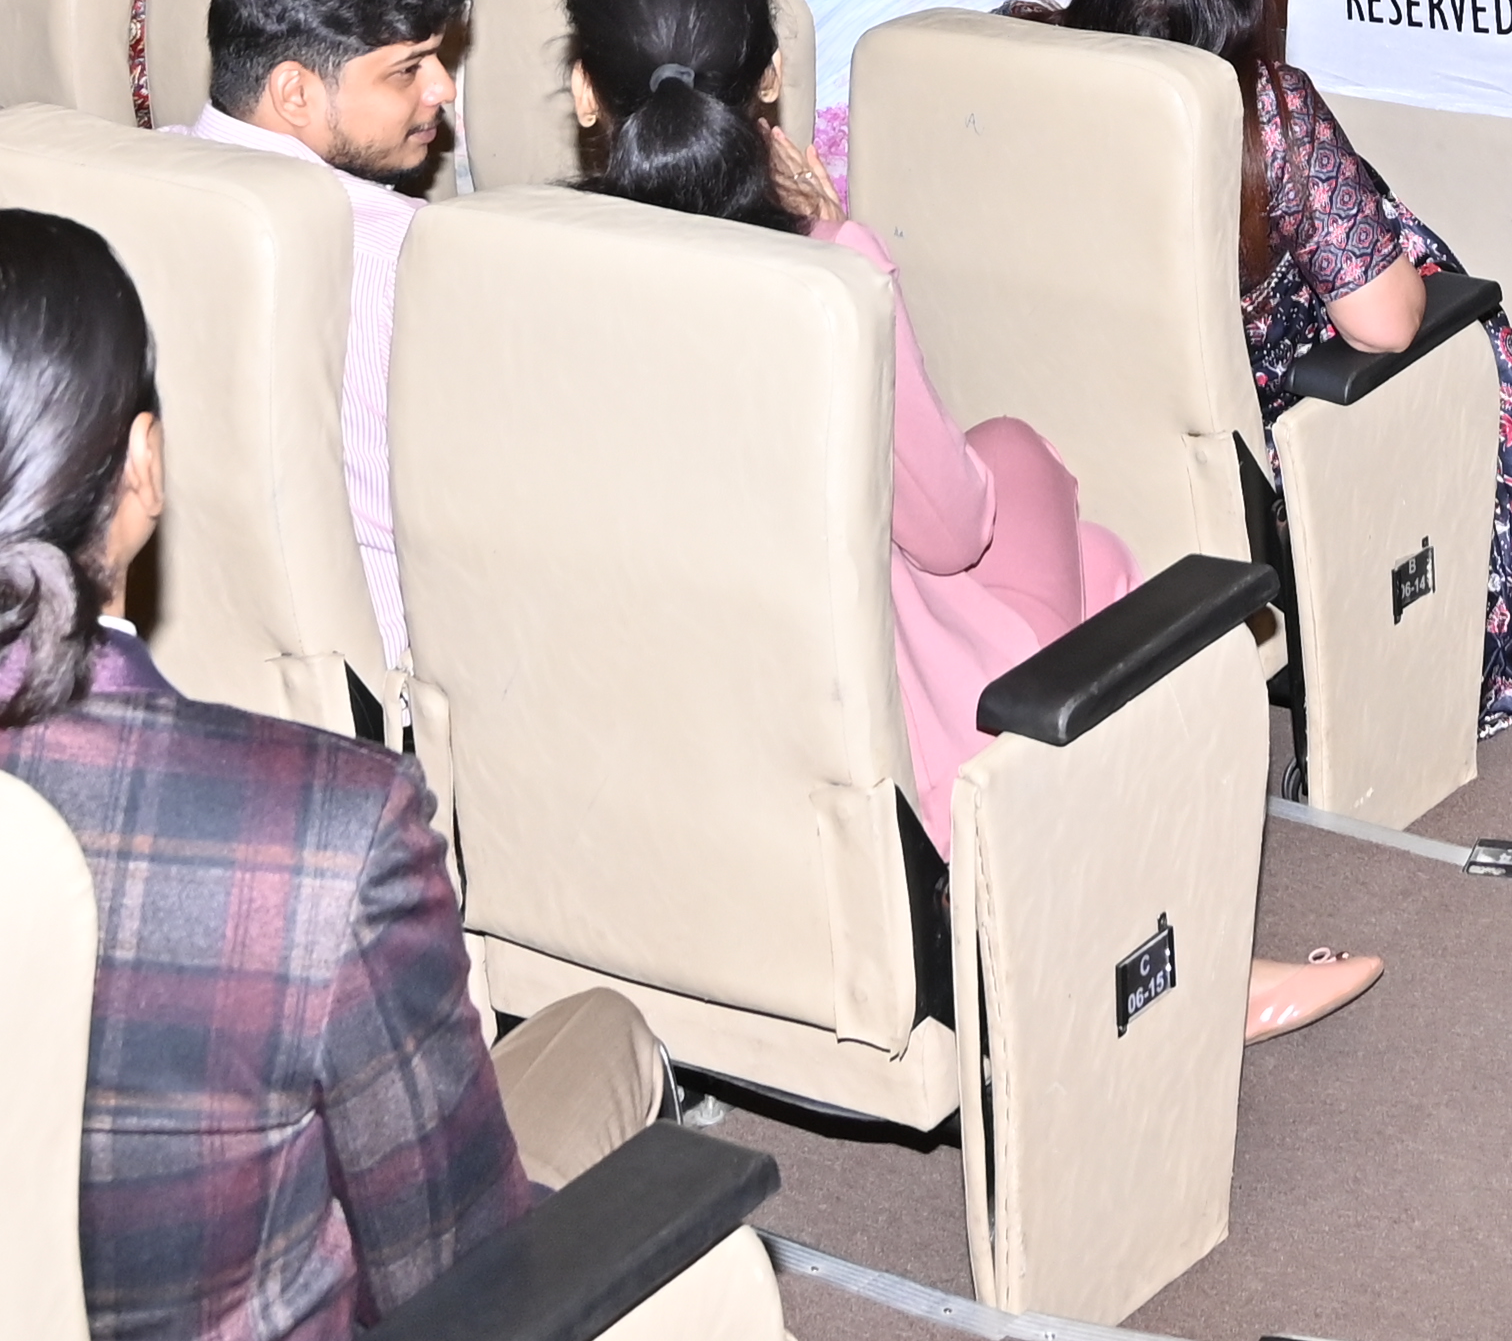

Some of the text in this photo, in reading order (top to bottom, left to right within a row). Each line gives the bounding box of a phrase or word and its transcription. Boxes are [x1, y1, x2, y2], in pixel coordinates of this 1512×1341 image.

[1408, 558, 1417, 575] B
[1139, 953, 1151, 977] C
[1127, 970, 1165, 1015] 06-15
